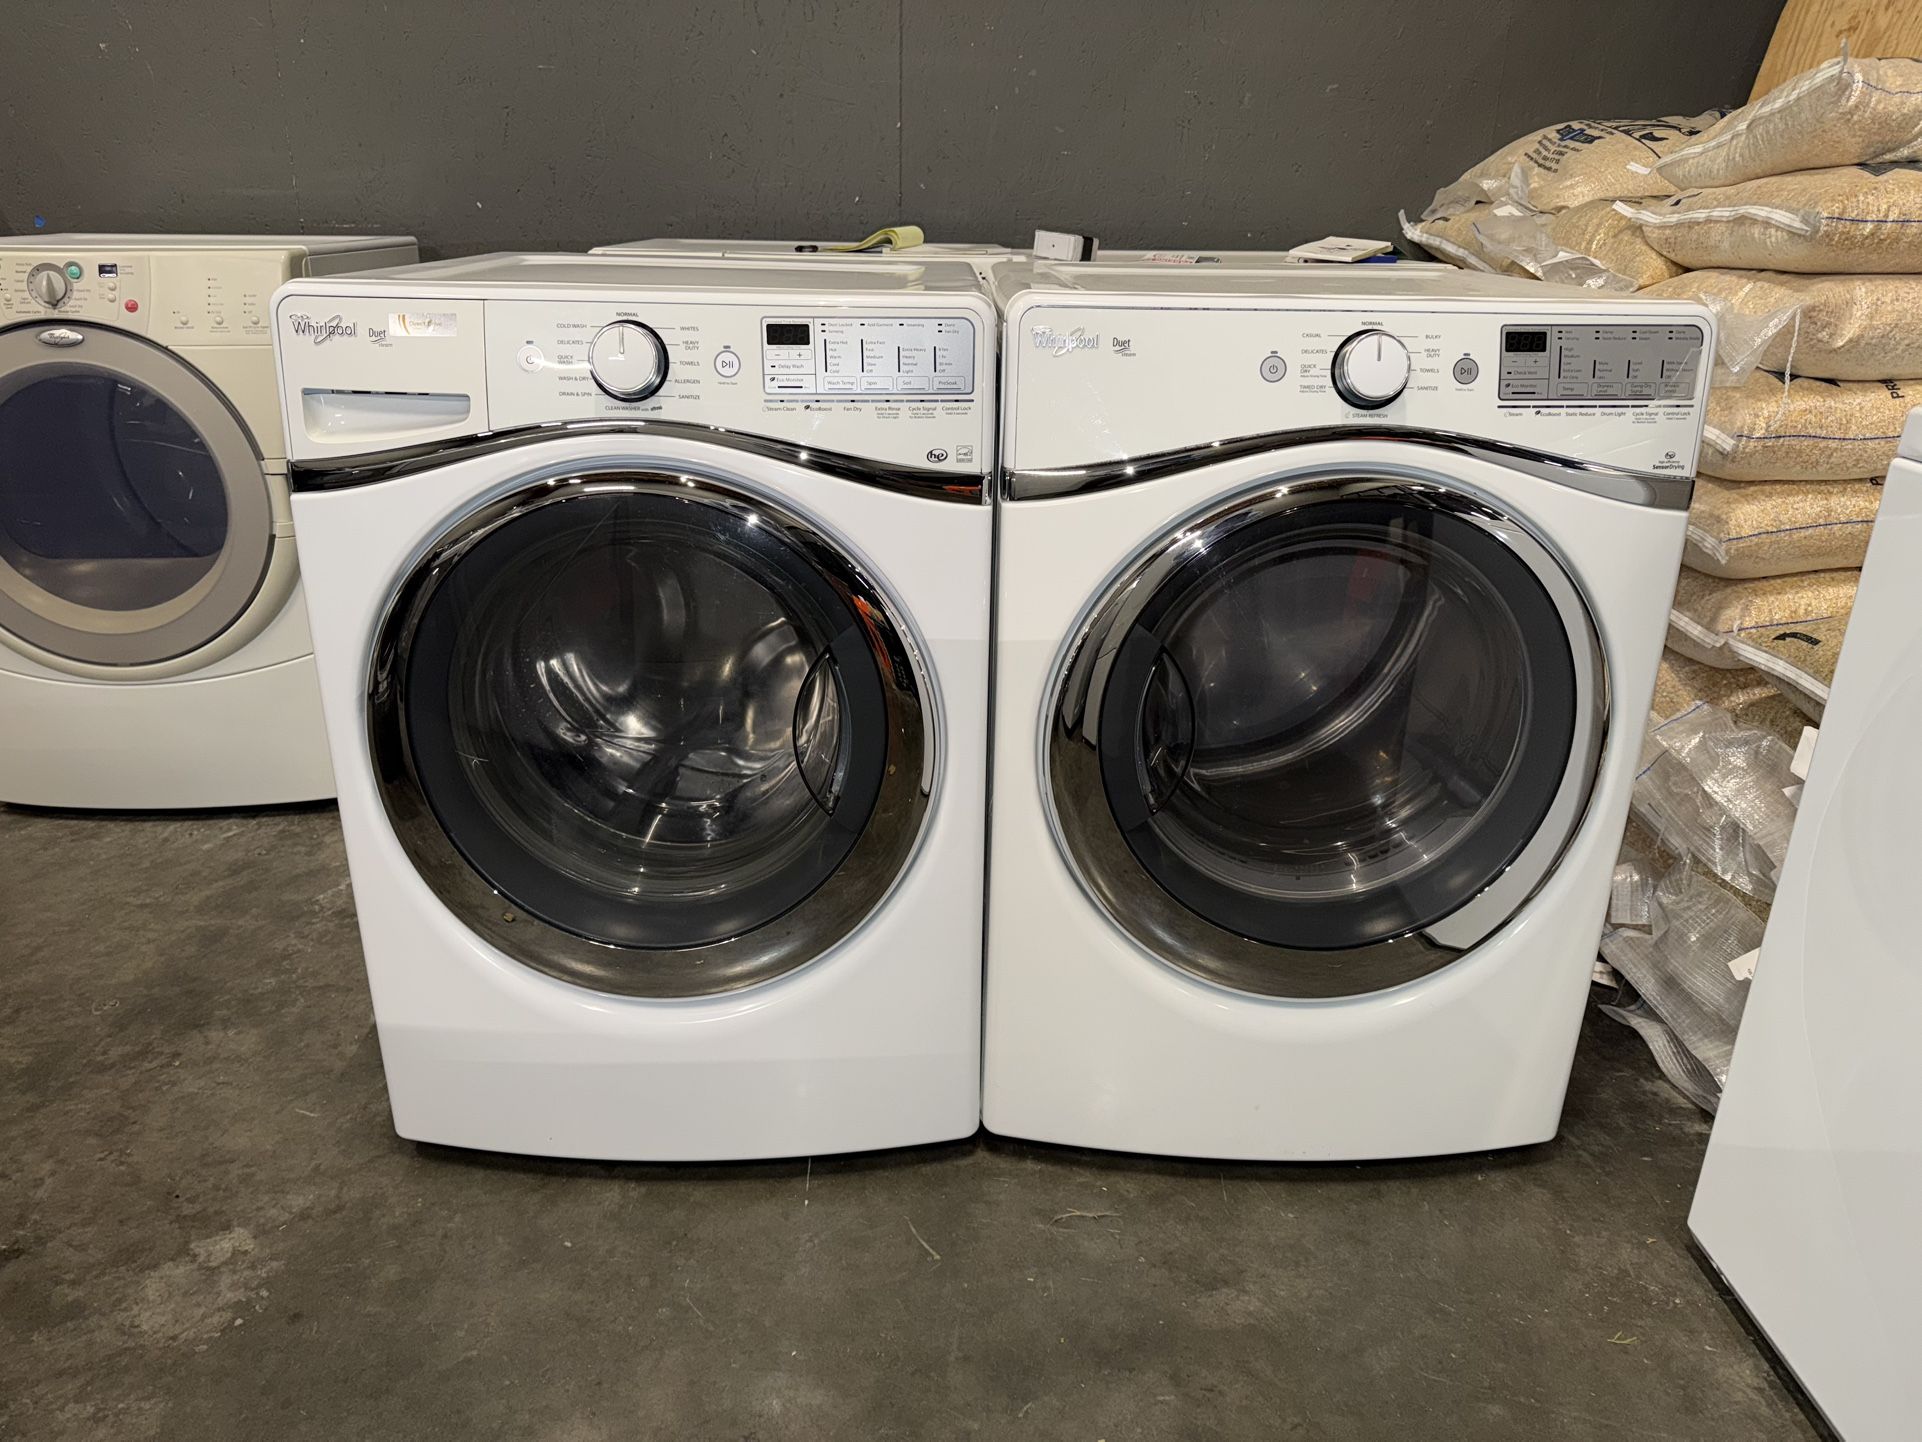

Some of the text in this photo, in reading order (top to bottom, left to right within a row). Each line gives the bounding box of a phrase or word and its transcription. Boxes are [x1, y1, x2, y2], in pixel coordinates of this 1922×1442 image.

[291, 317, 357, 341] Whirlpool
[369, 328, 386, 338] Duet
[1032, 328, 1099, 353] Whirlpool
[1112, 337, 1131, 347] Duet
[929, 449, 946, 461] he
